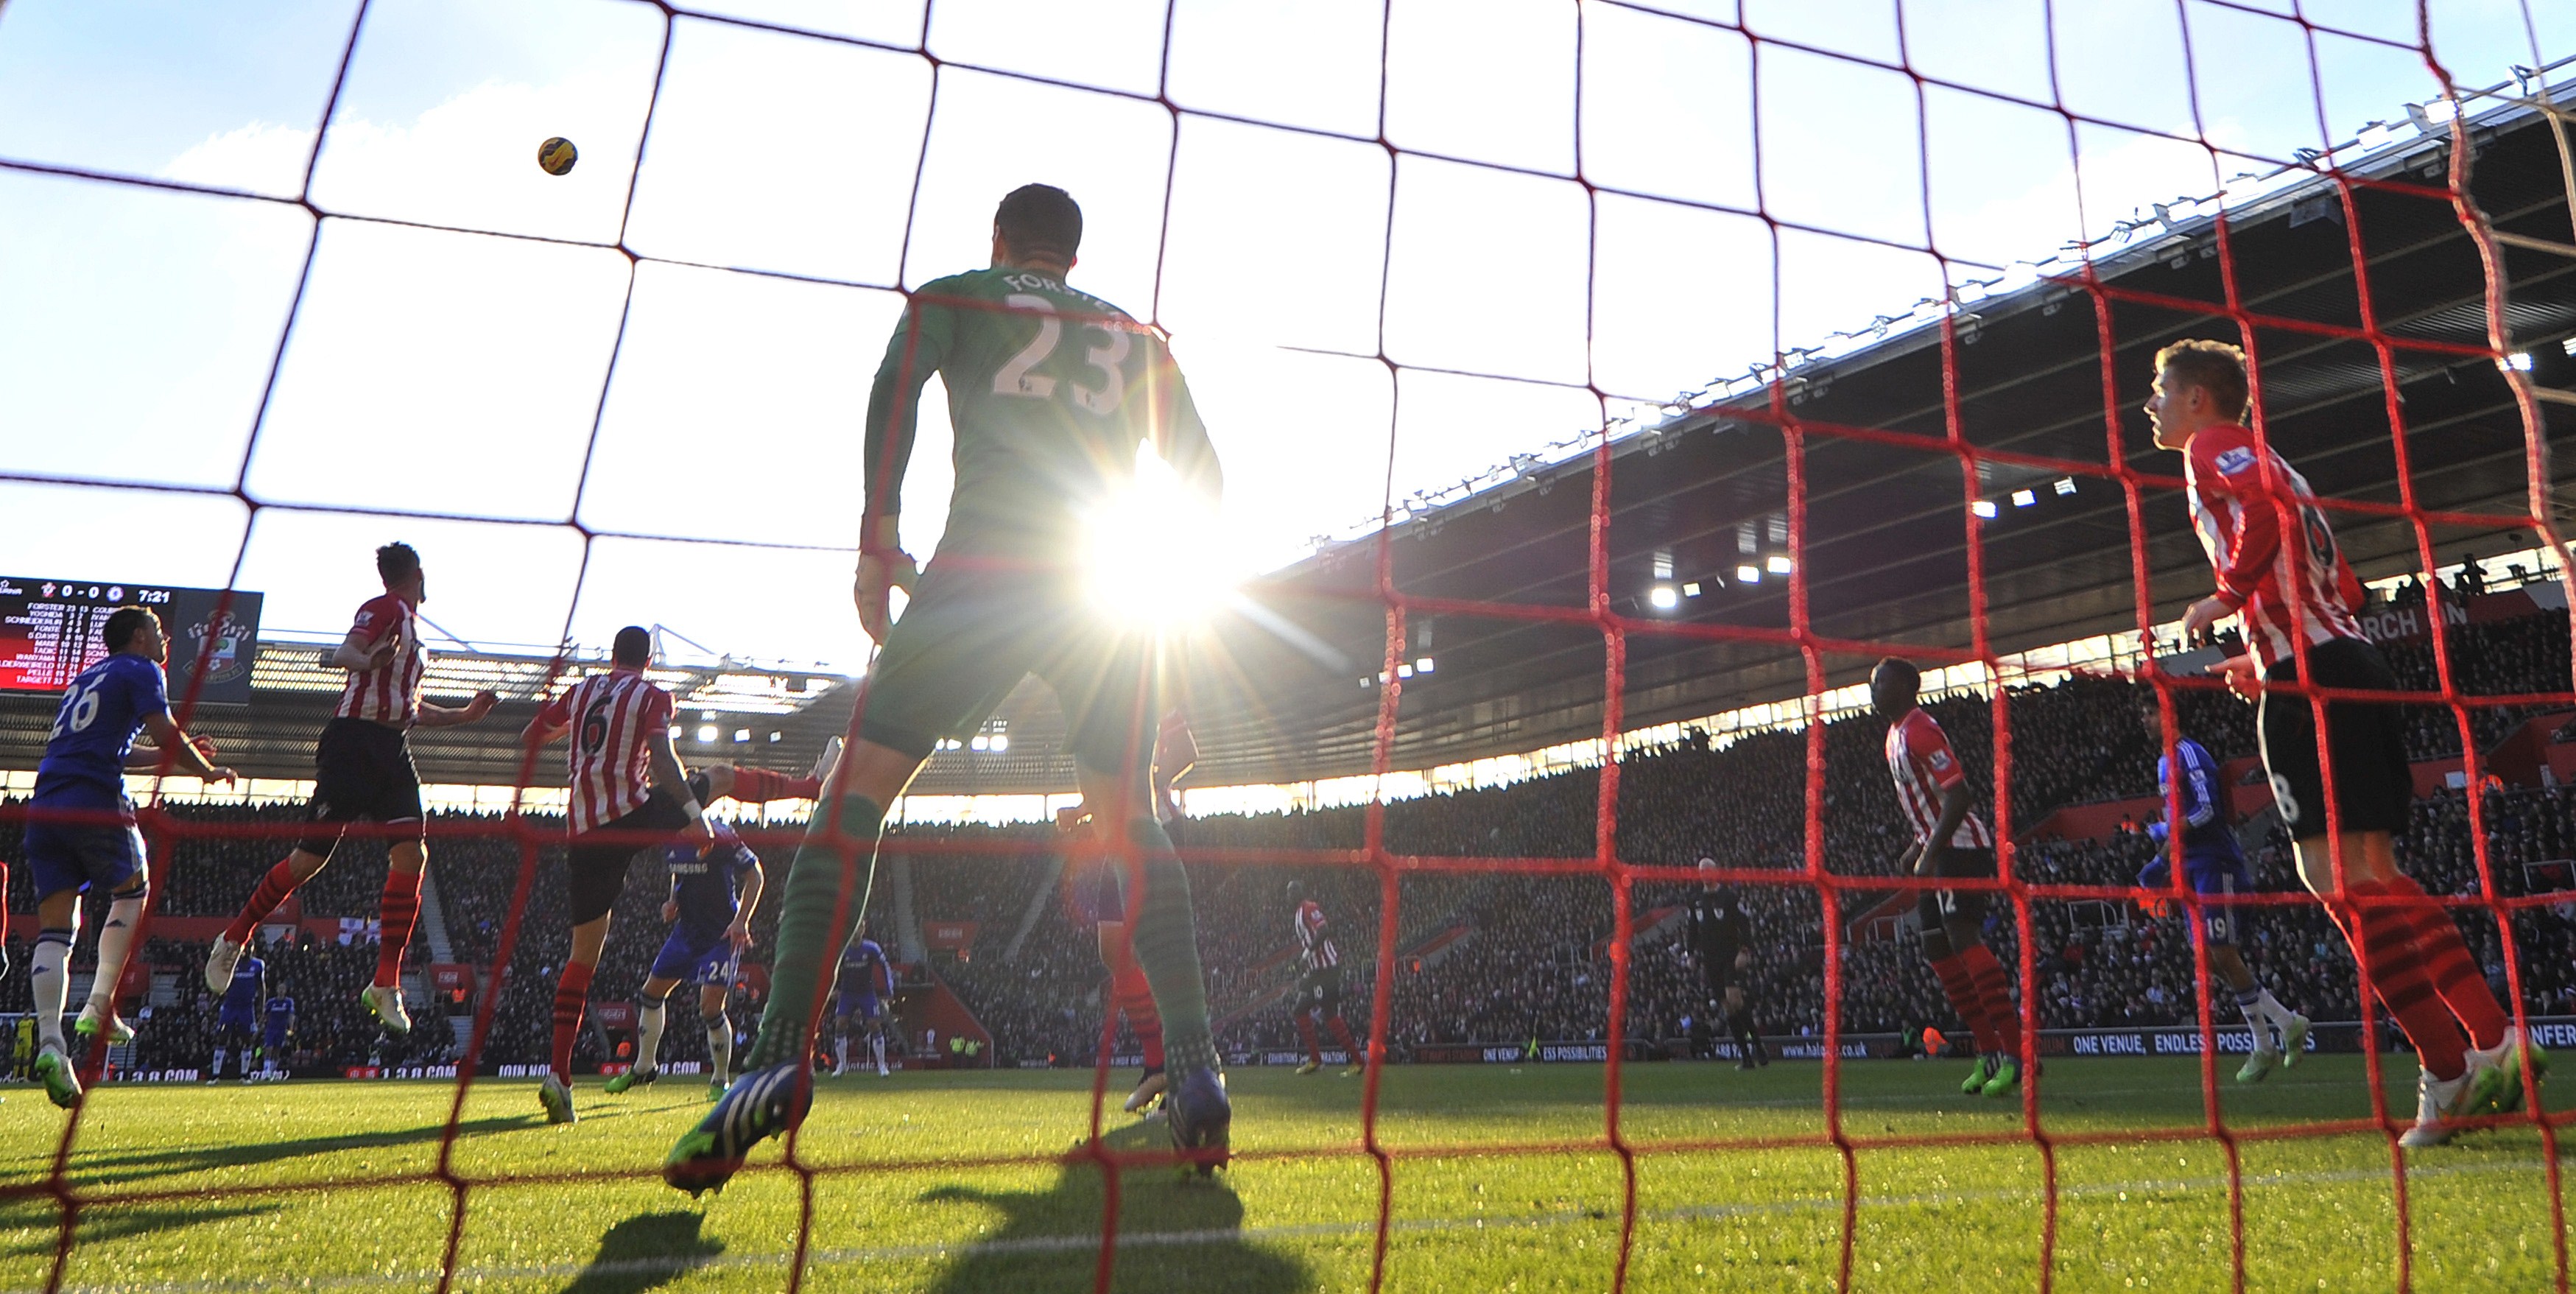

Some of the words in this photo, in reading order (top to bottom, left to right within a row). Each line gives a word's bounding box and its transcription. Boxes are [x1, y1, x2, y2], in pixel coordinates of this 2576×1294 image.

[993, 293, 1130, 415] 23
[61, 585, 72, 597] 0
[88, 586, 99, 598] 0
[139, 590, 170, 603] 7:21
[2362, 609, 2419, 641] RCH
[47, 672, 108, 742] 26
[581, 696, 613, 755] 6
[2273, 773, 2299, 824] 8
[1935, 888, 1957, 915] 12
[2207, 917, 2226, 938] 19
[708, 961, 729, 981] 24
[1314, 985, 1323, 999] 10
[2073, 1036, 2098, 1053] ONE
[2100, 1034, 2147, 1055] VENUE,
[2155, 1033, 2212, 1052] ENDLES
[2526, 1024, 2576, 1046] NFER
[1483, 1047, 1496, 1061] ONE
[1557, 1044, 1608, 1061] POSSIBILITIES
[499, 1064, 524, 1078] JOIN
[528, 1064, 550, 1077] NO
